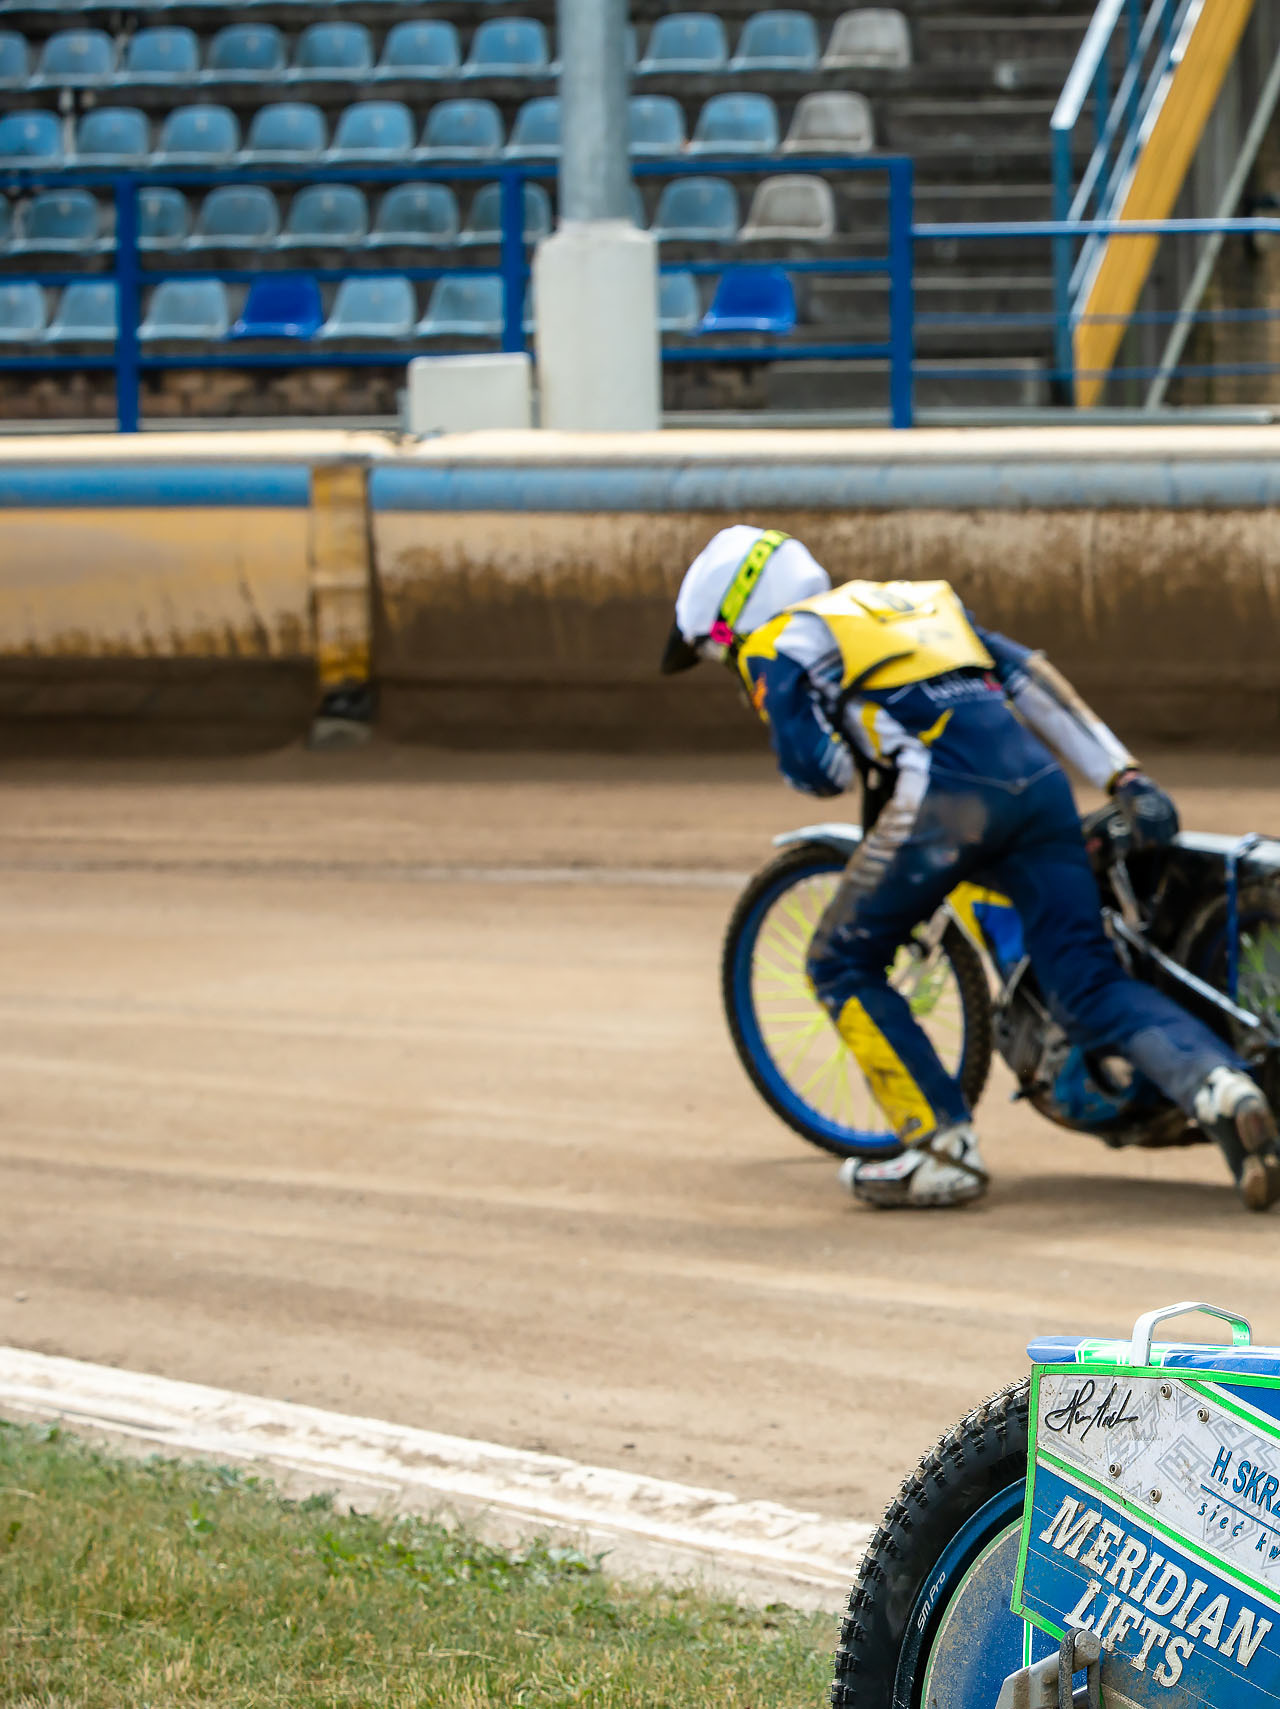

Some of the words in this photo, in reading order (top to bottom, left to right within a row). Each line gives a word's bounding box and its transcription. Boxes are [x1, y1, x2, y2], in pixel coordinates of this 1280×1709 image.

[929, 1571, 946, 1603] Pro
[1038, 1494, 1273, 1668] MERIDIAN
[1063, 1577, 1195, 1688] LIFTS
